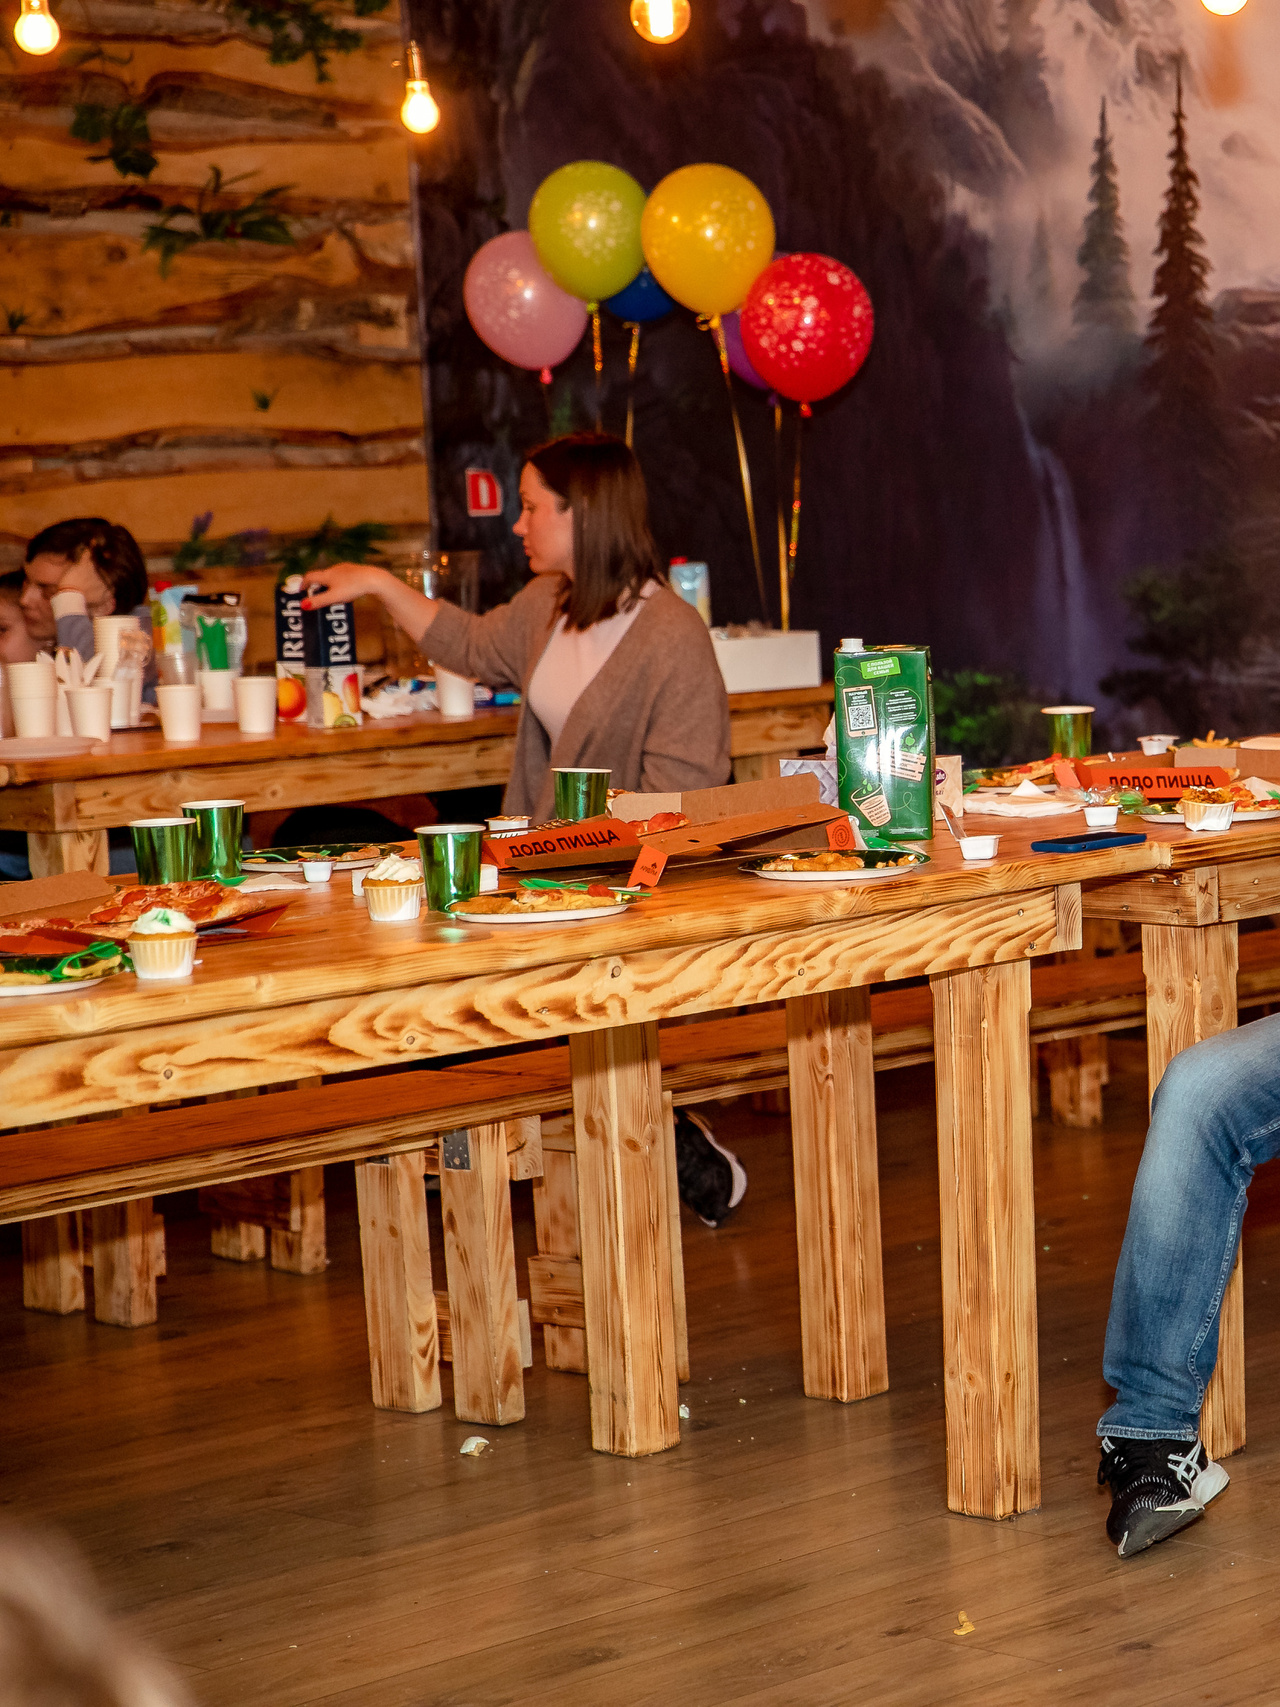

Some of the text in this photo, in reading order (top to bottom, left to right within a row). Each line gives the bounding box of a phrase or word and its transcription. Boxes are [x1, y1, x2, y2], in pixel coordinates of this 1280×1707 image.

[281, 600, 305, 658] Rich
[326, 603, 352, 663] Rich
[1156, 775, 1215, 789] ПИЦЦА
[509, 829, 621, 858] ДОДО ПИЦЦА
